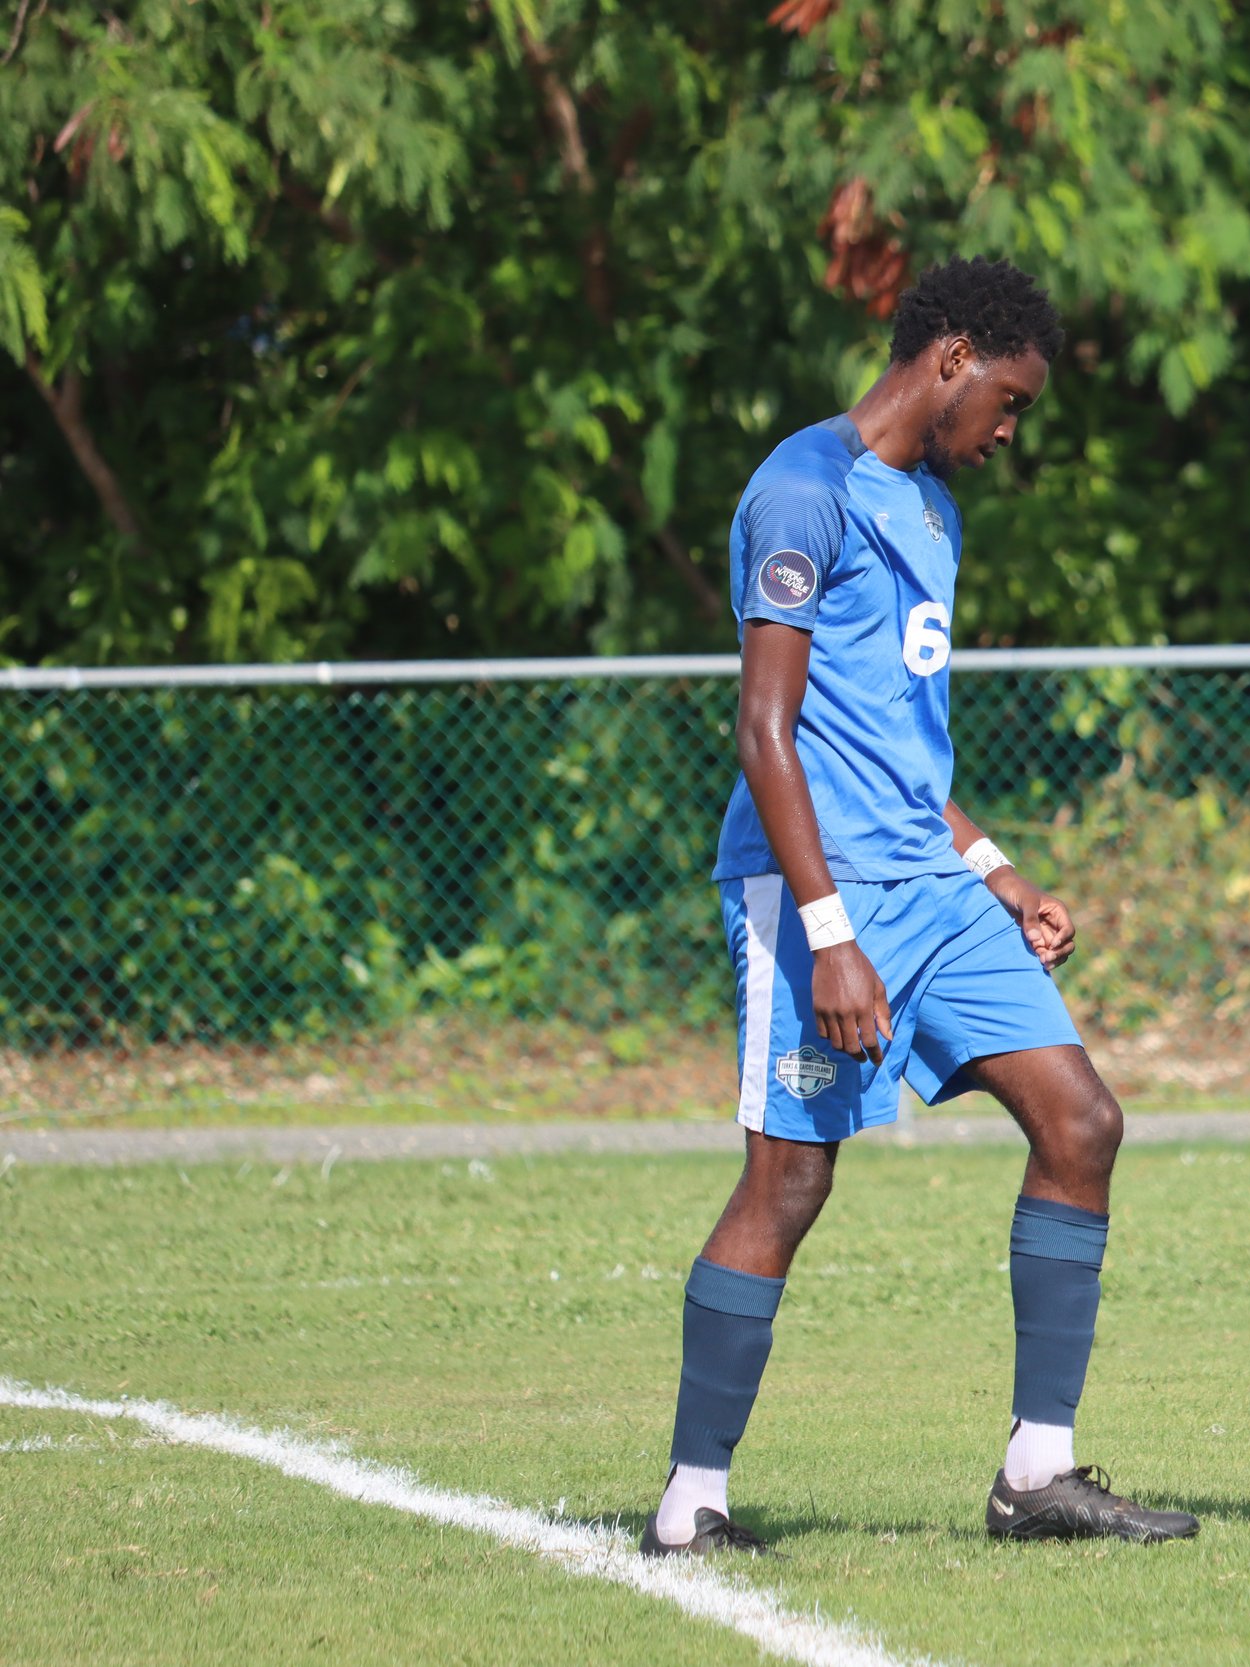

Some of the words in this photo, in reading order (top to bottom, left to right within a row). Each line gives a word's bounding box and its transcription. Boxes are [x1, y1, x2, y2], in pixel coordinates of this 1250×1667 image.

[774, 567, 805, 584] NATIONS
[781, 575, 809, 594] LEAGUE
[902, 600, 951, 676] 6
[781, 1062, 794, 1070] TURKS
[799, 1063, 814, 1071] CAICOS
[815, 1065, 831, 1075] ISLANDS
